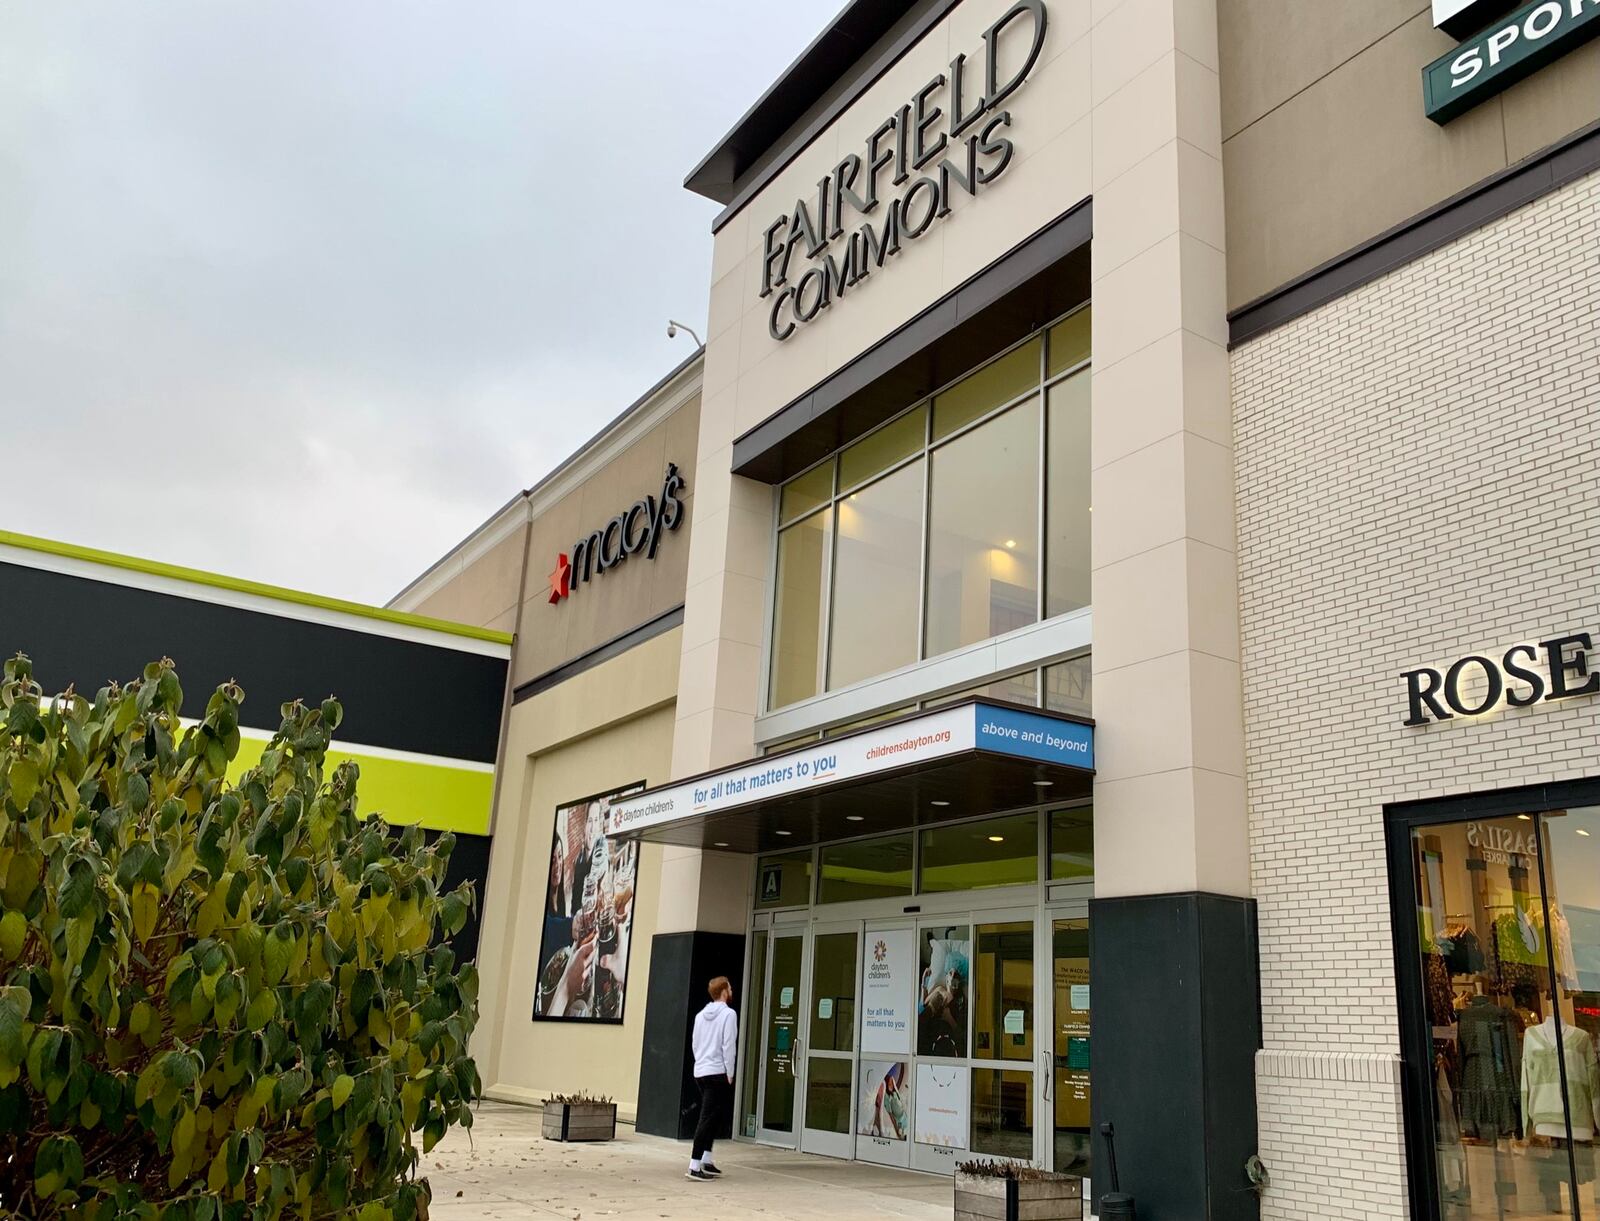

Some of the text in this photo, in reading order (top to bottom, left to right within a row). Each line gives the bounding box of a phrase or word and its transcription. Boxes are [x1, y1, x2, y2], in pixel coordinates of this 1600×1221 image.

[759, 0, 1048, 298] FAIRFIELD
[769, 111, 1014, 341] COMMONS
[570, 462, 686, 590] macy's
[1400, 632, 1600, 726] ROSE
[866, 729, 951, 759] childrensdayton.org
[982, 722, 1088, 753] above and beyond
[694, 755, 837, 804] for all that matters to you
[623, 800, 674, 822] dayton children's
[766, 871, 777, 892] A
[871, 963, 888, 972] dayton
[867, 1008, 875, 1016] for
[883, 1008, 894, 1016] that
[887, 1020, 894, 1028] to
[895, 1021, 905, 1030] you
